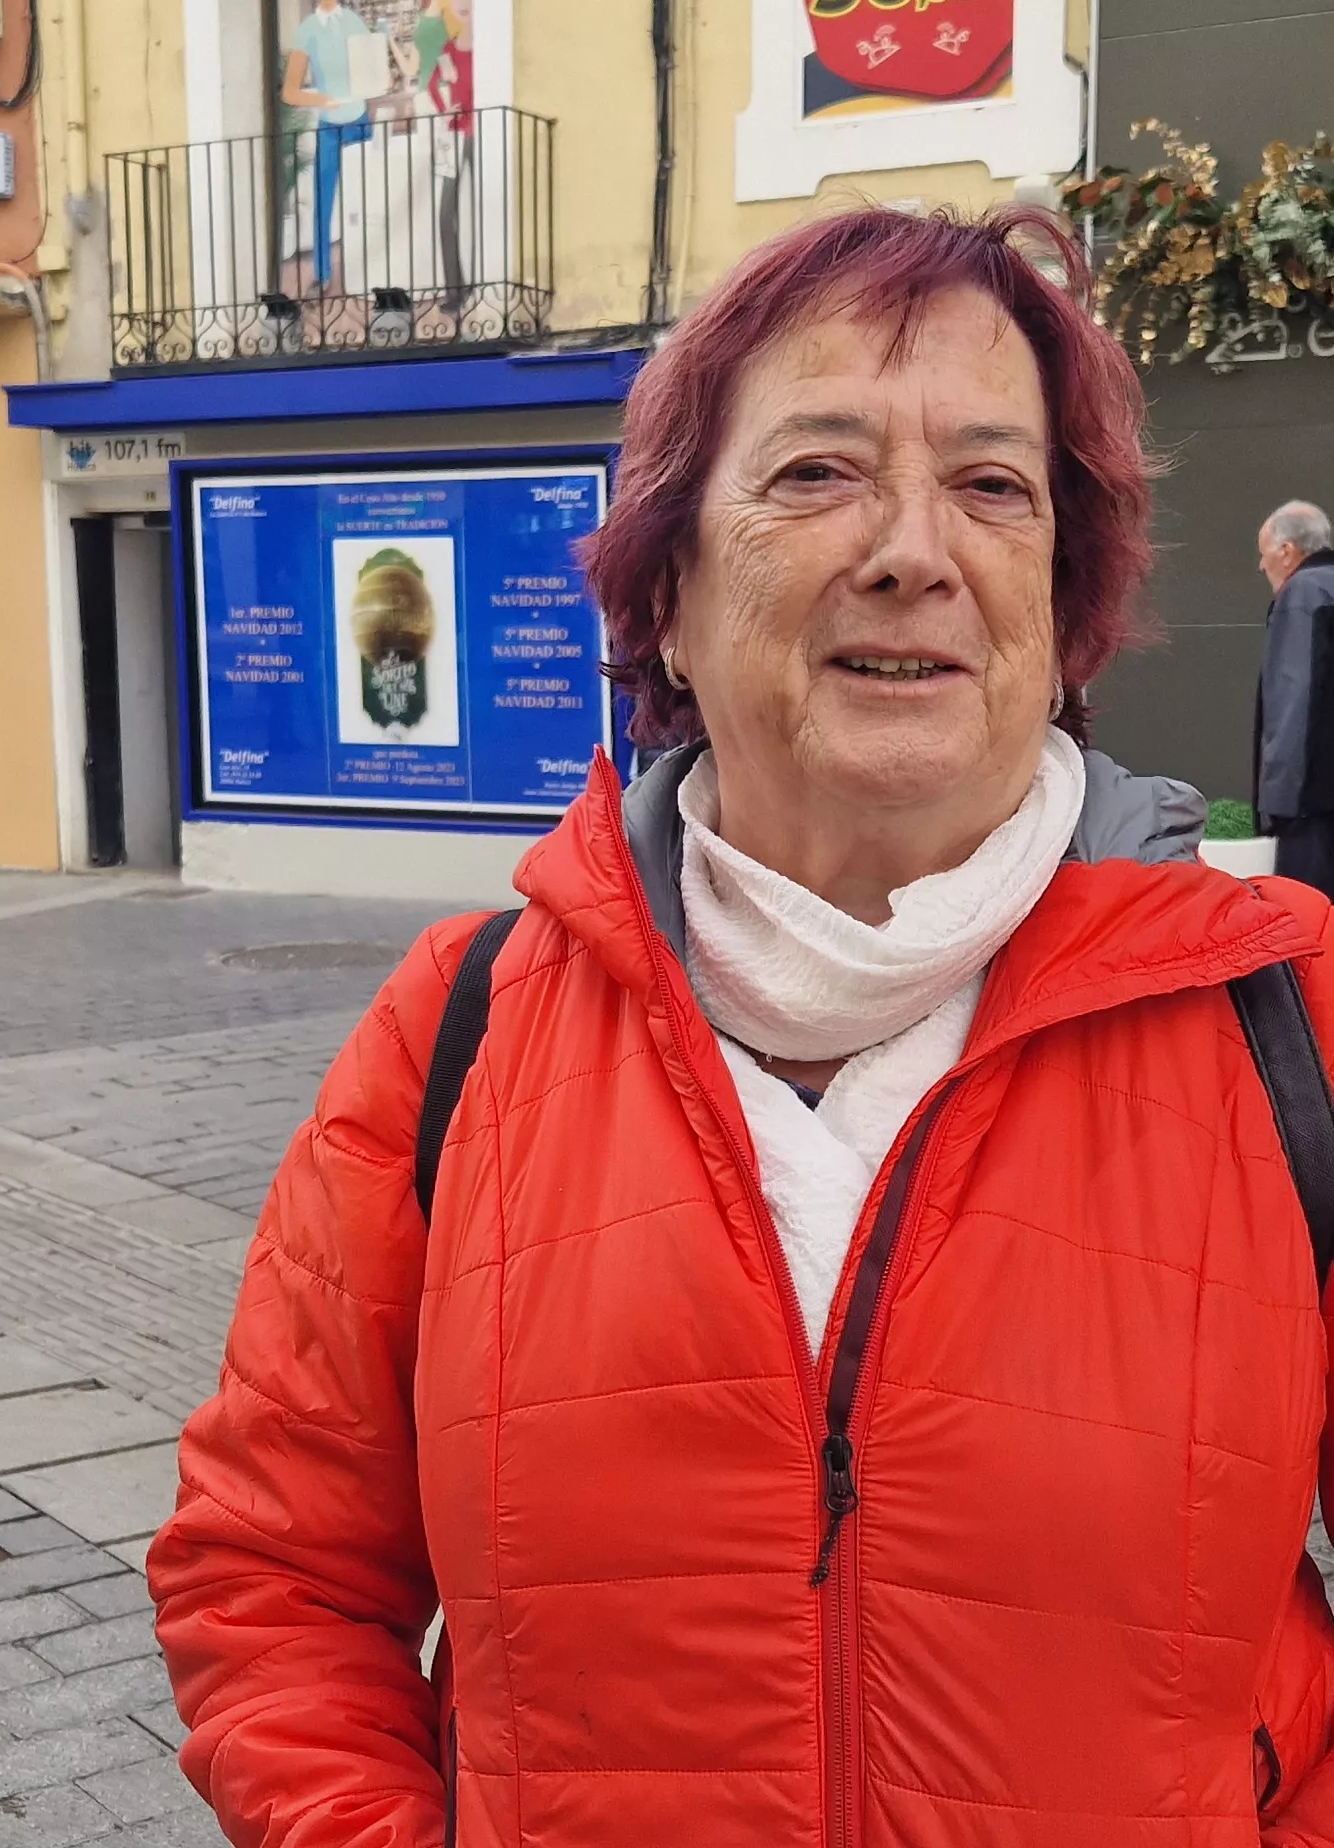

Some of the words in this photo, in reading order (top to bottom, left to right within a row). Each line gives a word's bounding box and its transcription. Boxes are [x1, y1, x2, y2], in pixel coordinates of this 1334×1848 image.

[156, 437, 182, 459] fm
[517, 576, 567, 590] PREMIO
[490, 594, 552, 608] NAVIDAD
[555, 594, 581, 608] 1997
[250, 606, 294, 619] PREMIO
[223, 623, 278, 636] NAVIDAD
[518, 627, 569, 641] PREMIO
[492, 645, 554, 659] NAVIDAD
[556, 645, 583, 659] 2005
[248, 654, 293, 667] PREMIO
[225, 671, 279, 683] NAVIDAD
[519, 678, 570, 692] PREMIO
[493, 694, 555, 708] NAVIDAD
